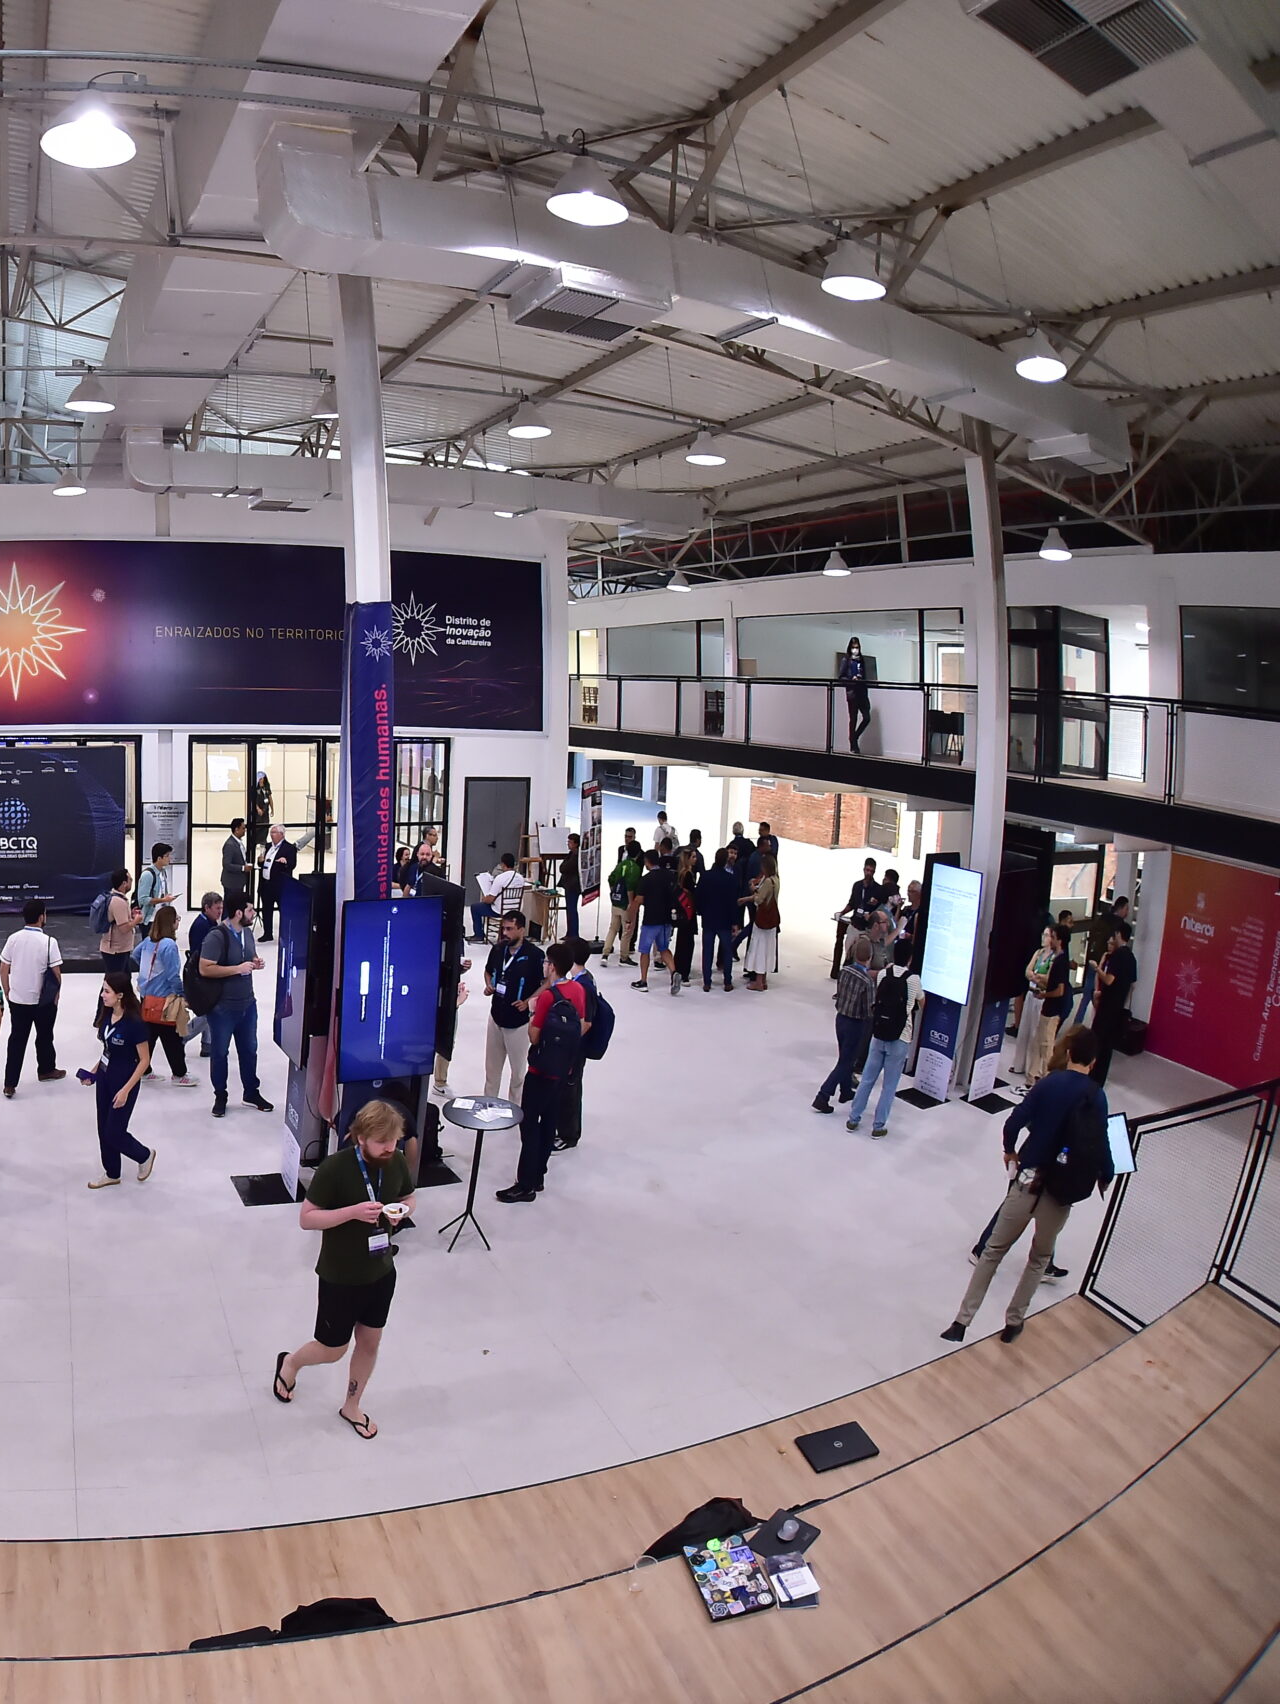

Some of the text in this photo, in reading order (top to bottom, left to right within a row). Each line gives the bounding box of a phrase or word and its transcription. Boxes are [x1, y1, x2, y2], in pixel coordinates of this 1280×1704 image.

[445, 615, 491, 627] Distrito de
[155, 625, 241, 639] ENRAIZADOS
[246, 627, 264, 639] NO
[446, 625, 491, 639] Inovação
[456, 638, 491, 647] Cantareira
[375, 684, 391, 899] ssibilidades humanas.
[1262, 995, 1272, 1021] Arte
